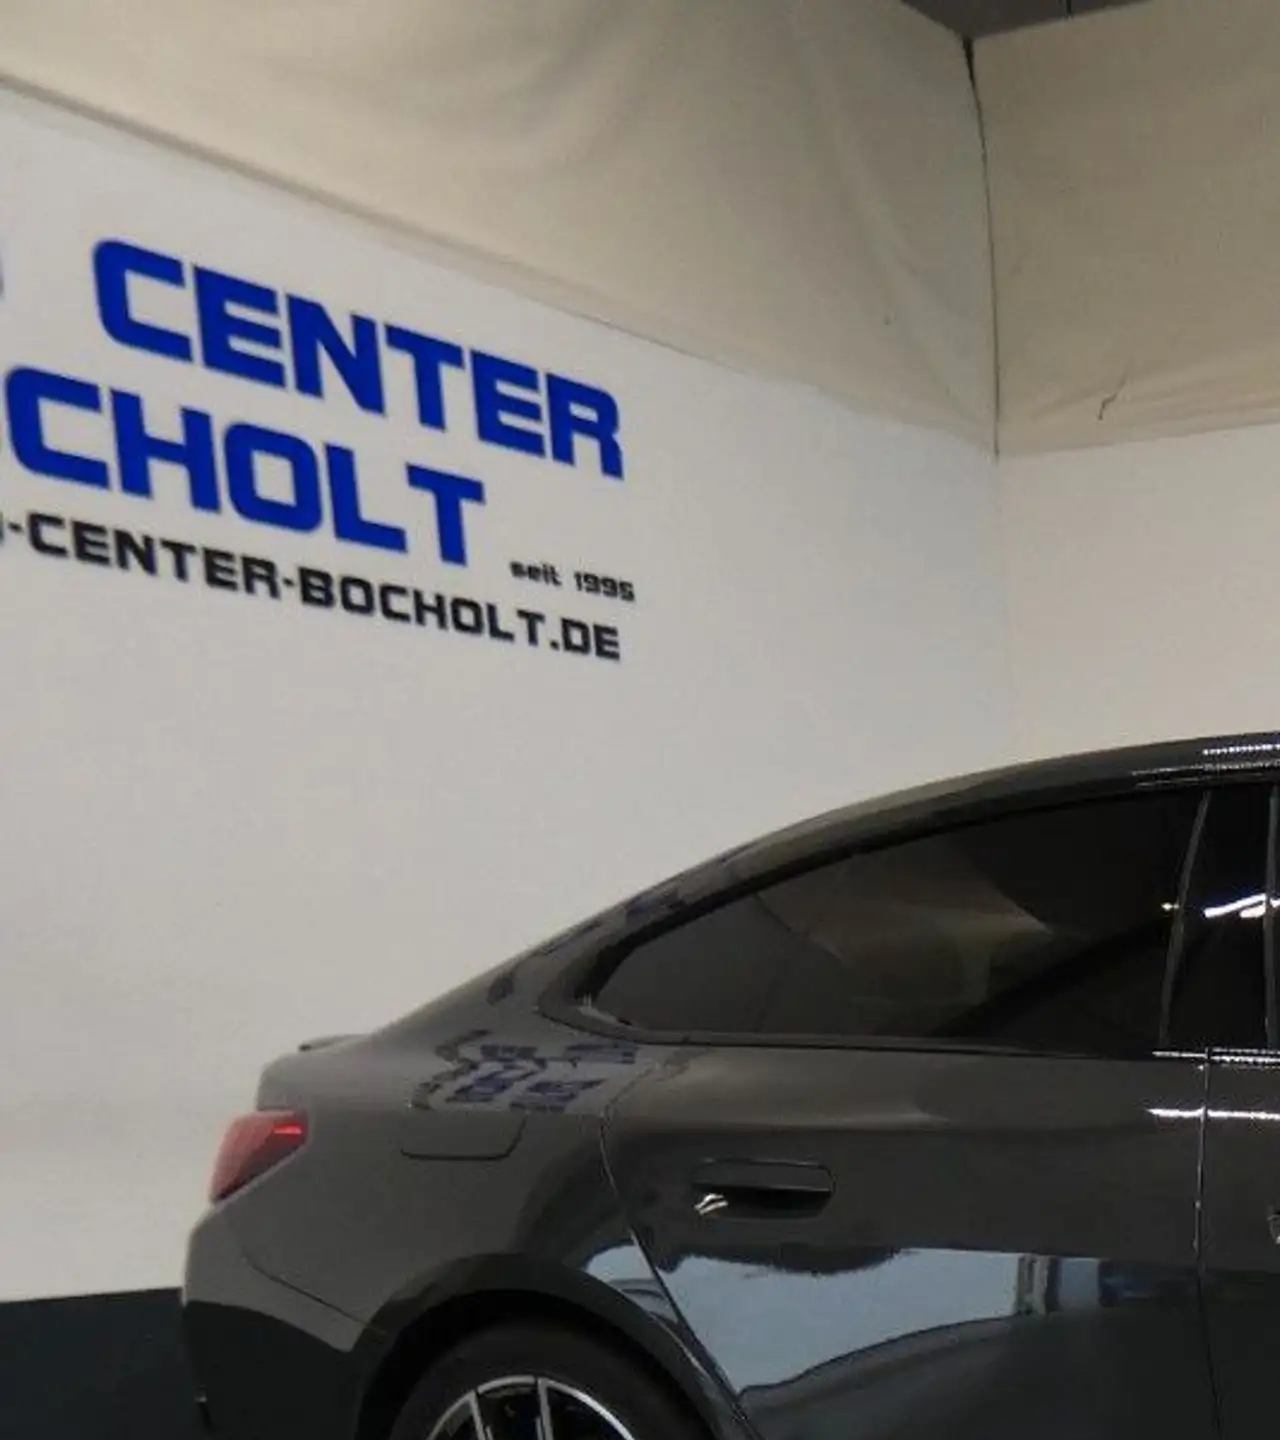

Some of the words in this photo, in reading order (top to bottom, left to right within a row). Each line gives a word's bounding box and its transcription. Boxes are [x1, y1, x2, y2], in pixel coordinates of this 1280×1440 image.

[92, 240, 624, 479] CENTER
[0, 511, 621, 661] -CENTER-BOCHOLT.DE
[510, 560, 562, 587] seit
[572, 571, 636, 602] 1995
